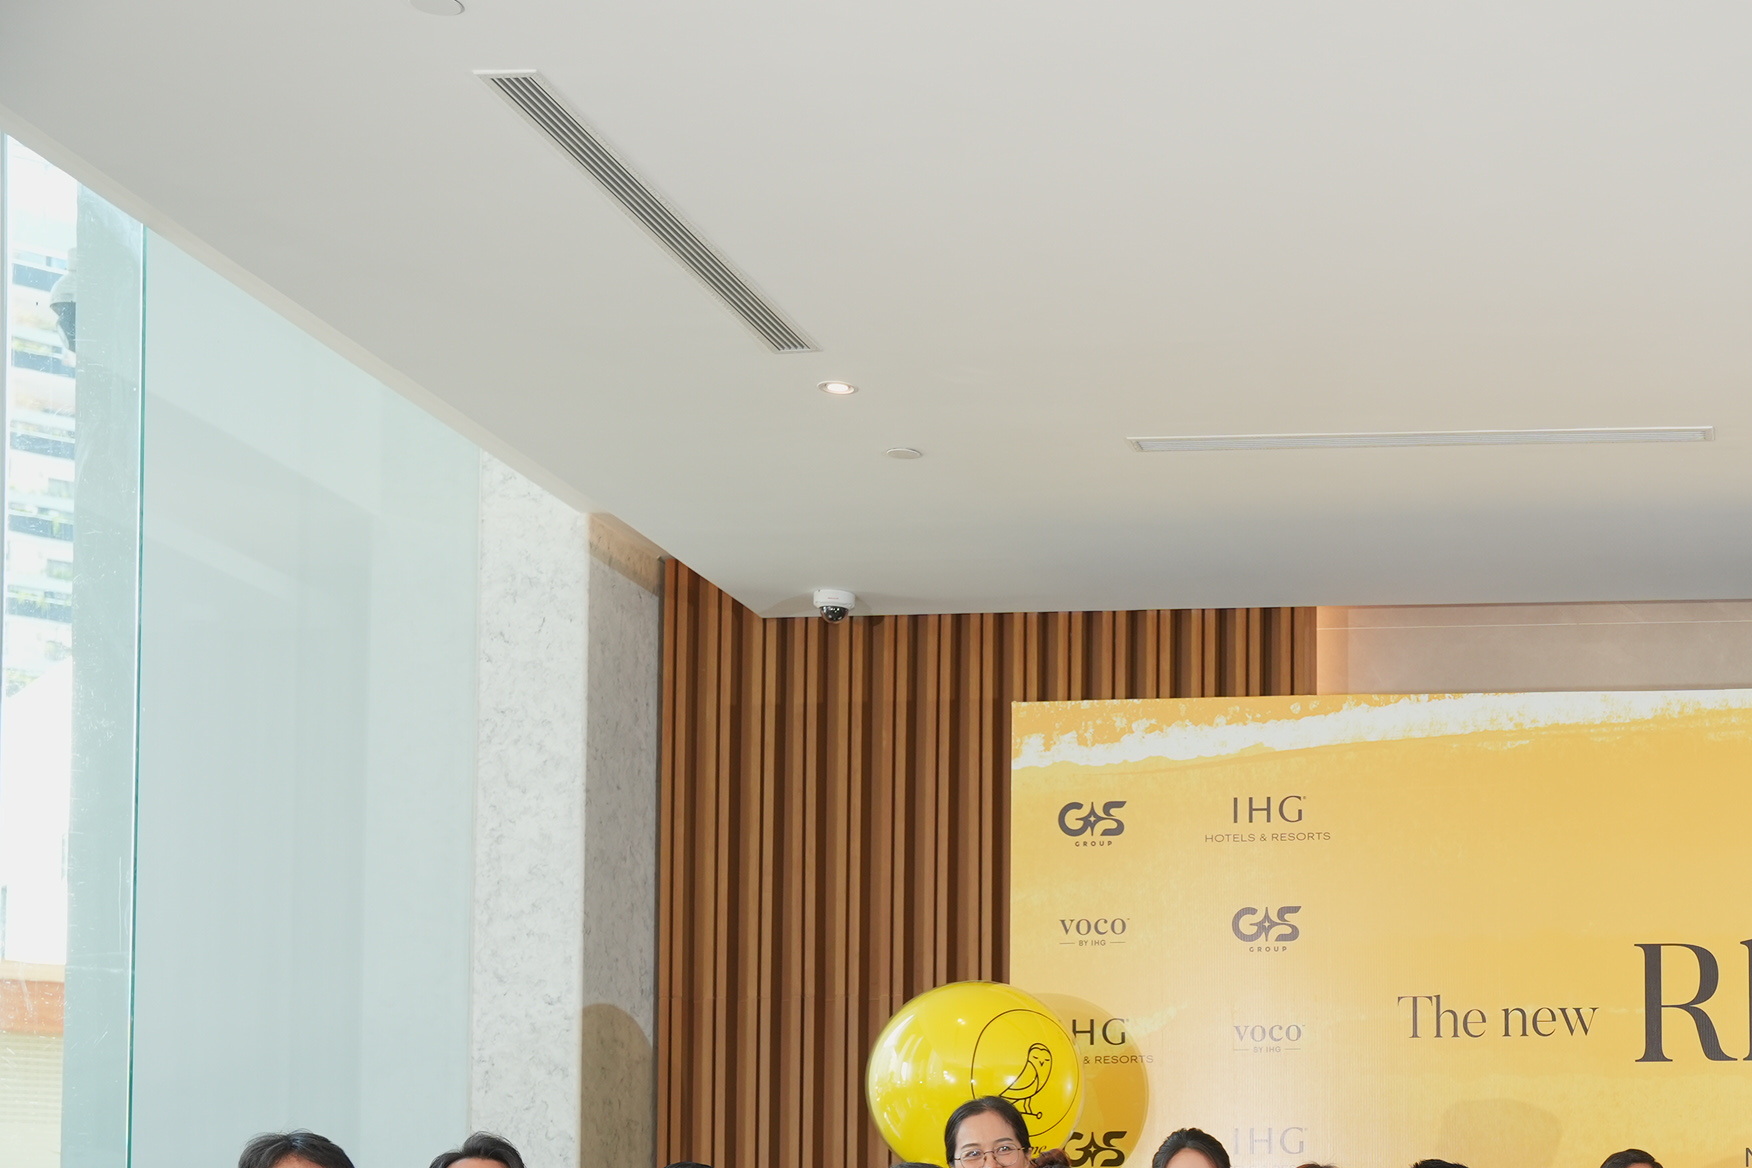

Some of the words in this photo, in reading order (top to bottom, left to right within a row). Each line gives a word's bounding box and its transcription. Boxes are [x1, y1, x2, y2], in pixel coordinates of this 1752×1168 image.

[1232, 795, 1304, 824] IHG
[1204, 833, 1256, 843] HOTELS
[1259, 832, 1268, 842] &
[1271, 831, 1332, 842] RESORTS
[1397, 994, 1487, 1039] The
[1501, 1006, 1599, 1038] new
[1094, 1055, 1154, 1064] RESORTS
